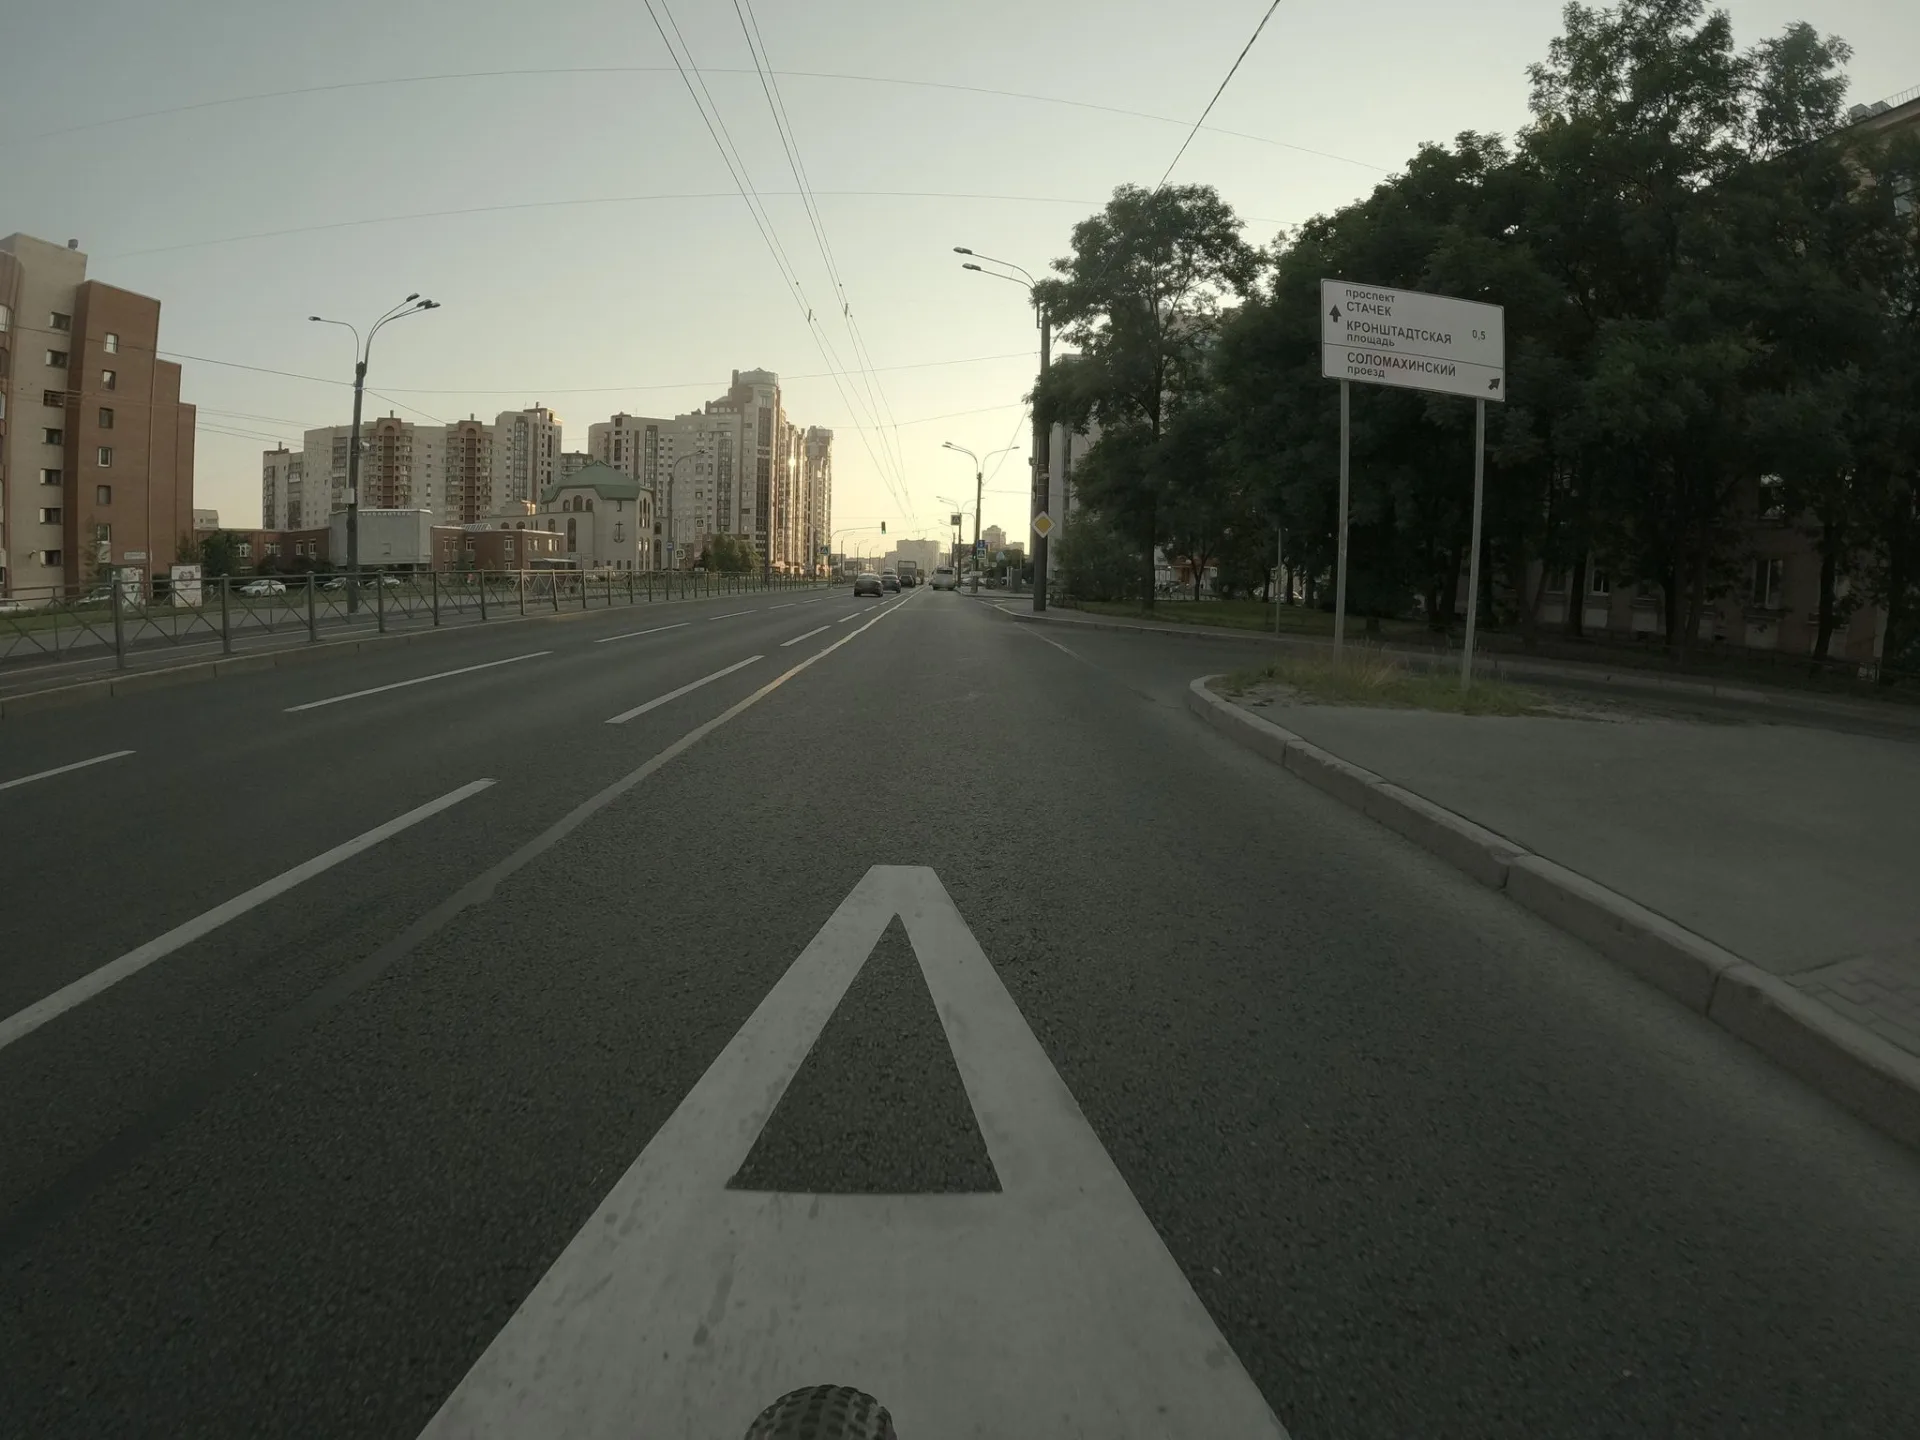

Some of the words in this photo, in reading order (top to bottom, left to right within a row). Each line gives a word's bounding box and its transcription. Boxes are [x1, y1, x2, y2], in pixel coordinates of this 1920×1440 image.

[1345, 288, 1395, 303] проспект
[1346, 301, 1392, 317] СТАЧЕК
[1346, 320, 1452, 345] КРОНШТАДТСКАЯ
[1346, 333, 1395, 347] площадь
[1347, 351, 1456, 377] СОЛОМАХИНСКИЙ
[1347, 365, 1386, 379] проезд
